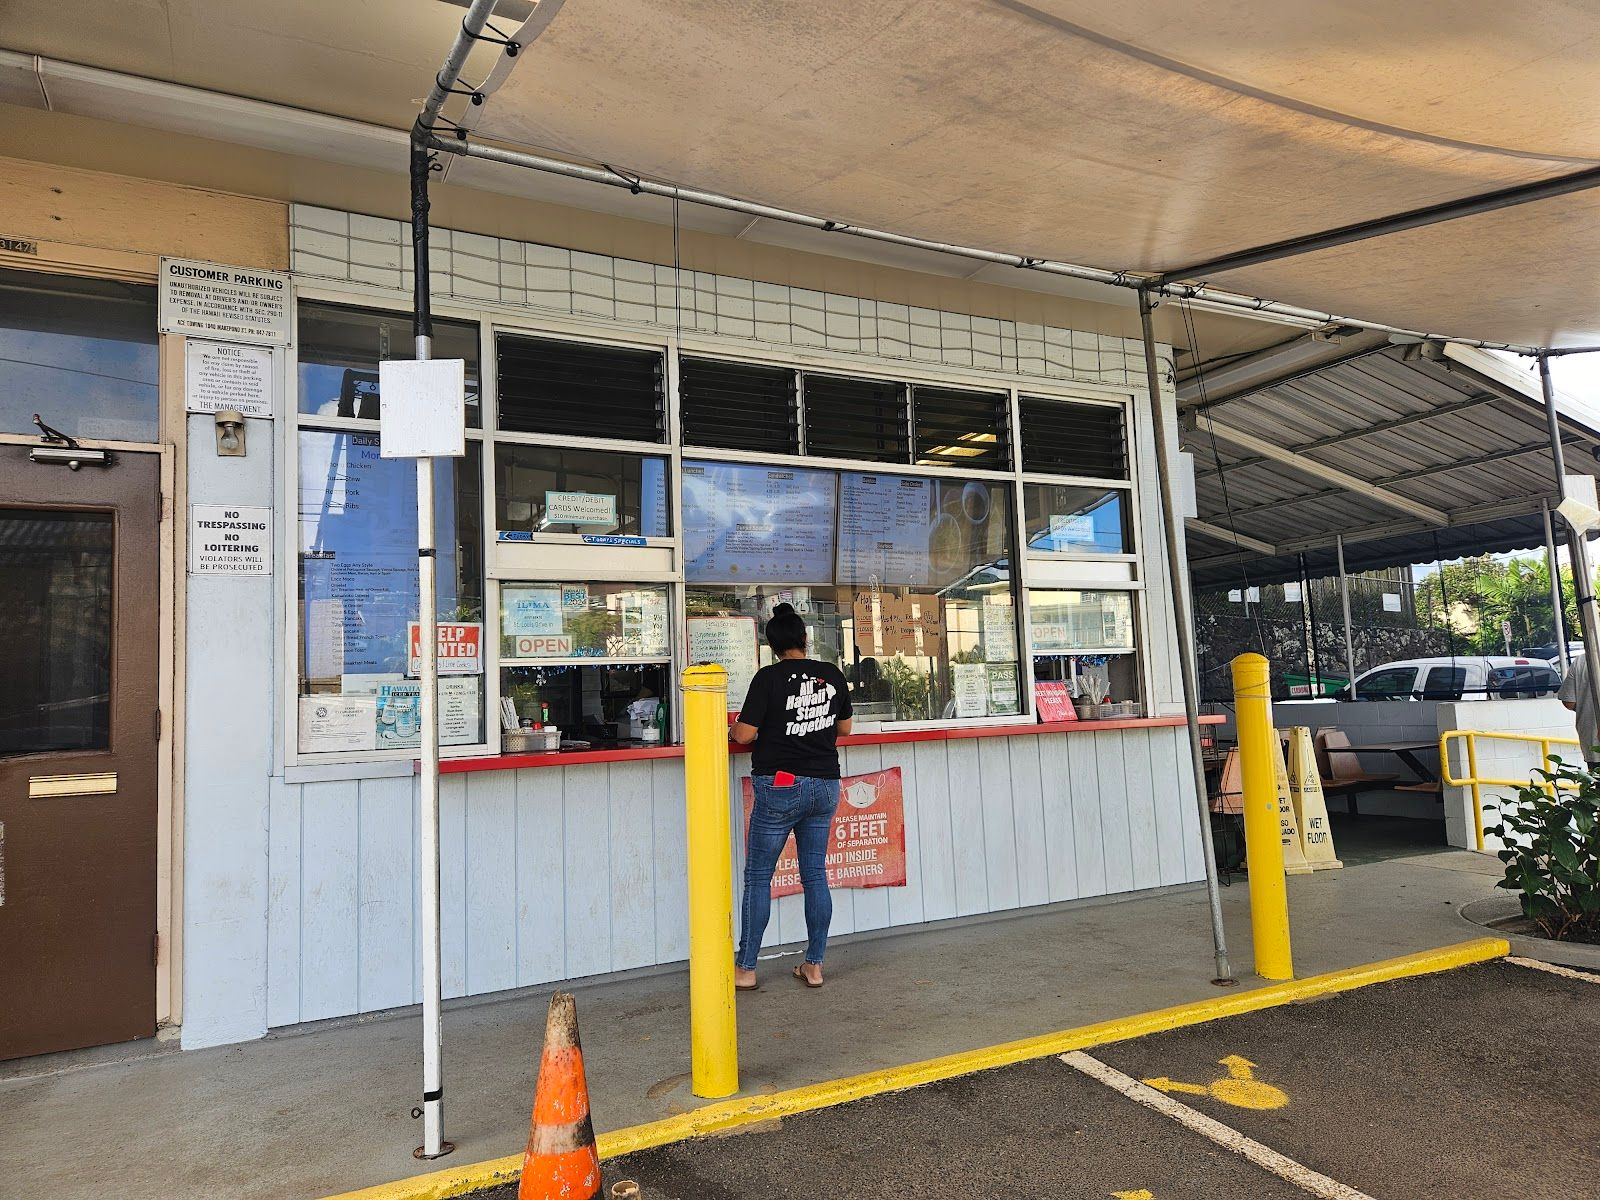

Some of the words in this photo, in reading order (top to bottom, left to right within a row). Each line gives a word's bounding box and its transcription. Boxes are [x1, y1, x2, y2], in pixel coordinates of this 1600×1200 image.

[169, 265, 229, 281] CUSTOMER
[234, 274, 283, 290] PARKING
[169, 281, 211, 293] UNAUTHORIZED
[212, 286, 237, 297] VEHICLES
[239, 290, 251, 298] WILL
[252, 291, 260, 299] BE
[260, 292, 283, 303] SUBJECT
[179, 290, 203, 300] REMOVAL
[190, 307, 201, 315] THE
[222, 312, 244, 322] REVISED
[203, 302, 238, 313] ACCORDANCE
[239, 306, 253, 315] WITH
[200, 401, 213, 409] THE
[352, 437, 371, 446] Daily
[346, 462, 371, 470] Chicken
[557, 494, 605, 504] CREDIT/DEBIT
[548, 503, 572, 512] CARDS
[573, 505, 611, 514] Welcomed!
[224, 511, 239, 519] NO
[197, 520, 266, 531] TRESPASSING
[224, 533, 239, 541] NO
[204, 544, 259, 553] LOITERING
[199, 555, 243, 563] VIOLATORS
[212, 563, 263, 571] PROSECUTED
[563, 592, 586, 600] BEST
[437, 627, 465, 641] ELP
[1033, 627, 1065, 638] OPEN
[414, 642, 476, 657] NTED
[519, 638, 569, 653] OPEN
[992, 671, 1014, 679] PASS
[800, 680, 814, 696] All
[785, 688, 826, 710] Hawaii
[796, 700, 831, 721] Stand
[785, 714, 837, 737] Together
[835, 815, 858, 823] PLEASE
[858, 812, 887, 821] MAINTAIN
[1308, 817, 1323, 829] WET
[835, 824, 847, 839] 6
[850, 820, 888, 838] FEET
[837, 841, 847, 849] OF
[847, 836, 888, 848] SEPARATION
[1307, 832, 1329, 844] FLOOR
[824, 854, 843, 865] AND
[846, 849, 877, 863] INSIDE
[837, 863, 884, 879] BARRIERS
